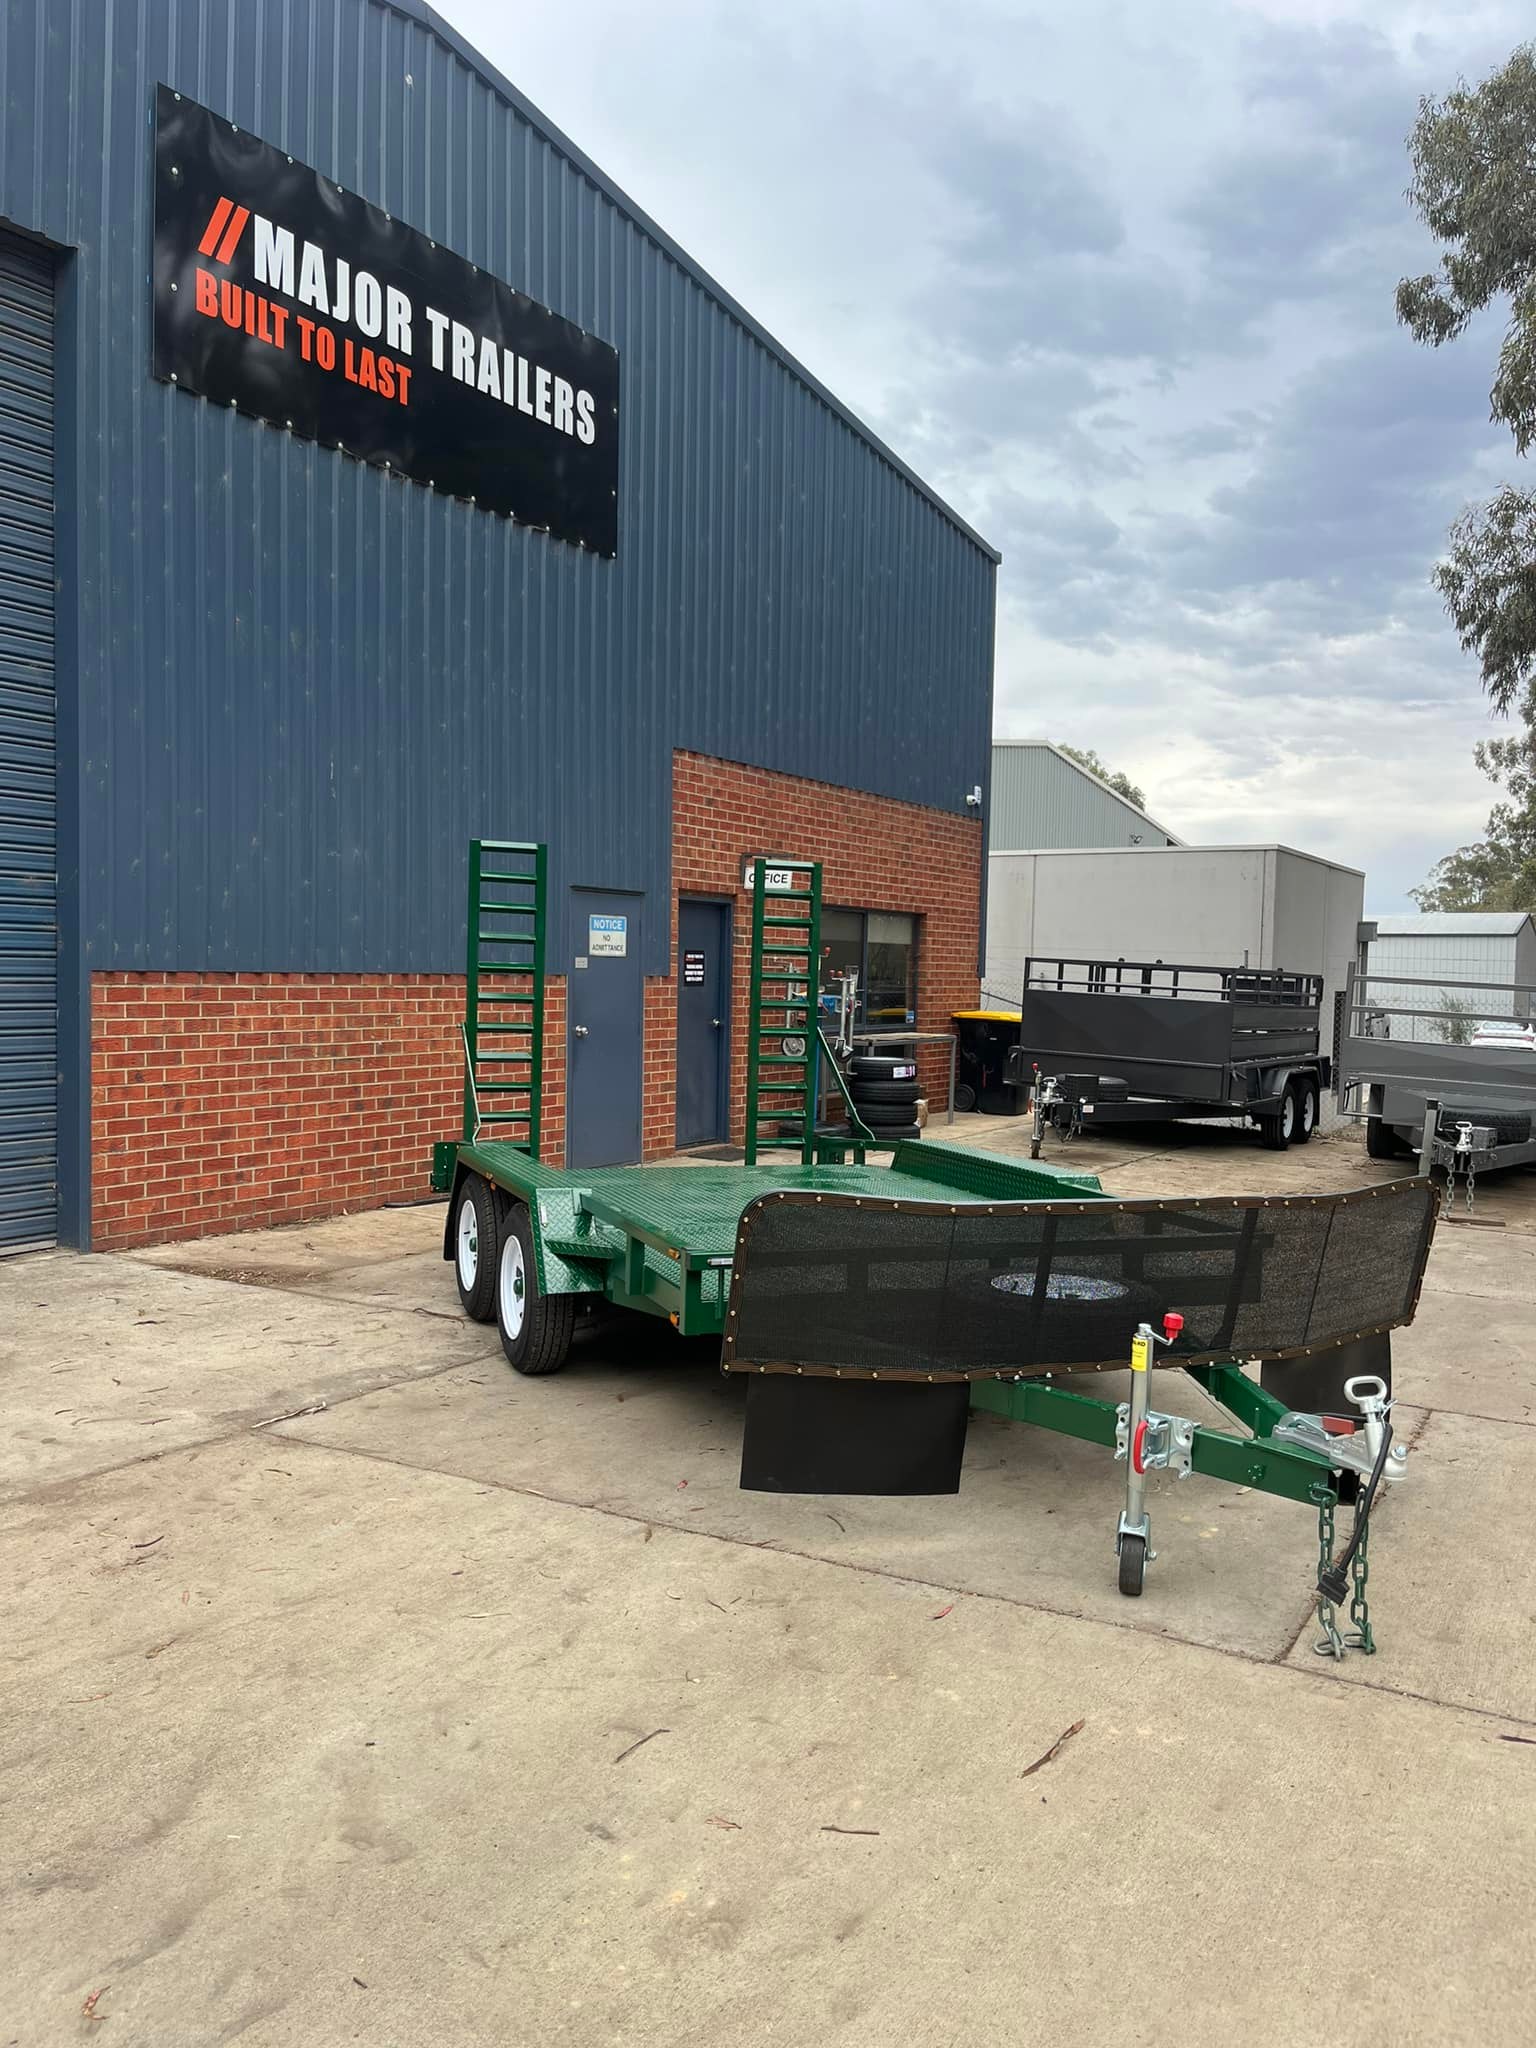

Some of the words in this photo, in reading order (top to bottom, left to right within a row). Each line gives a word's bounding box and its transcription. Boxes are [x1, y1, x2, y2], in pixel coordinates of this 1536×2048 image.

[196, 267, 289, 349] BUILT
[297, 315, 336, 371] TO
[345, 338, 412, 406] LAST
[426, 306, 596, 445] TRAILERS
[748, 873, 788, 884] OFICE
[593, 919, 623, 930] NOTICE
[602, 934, 611, 942] NO
